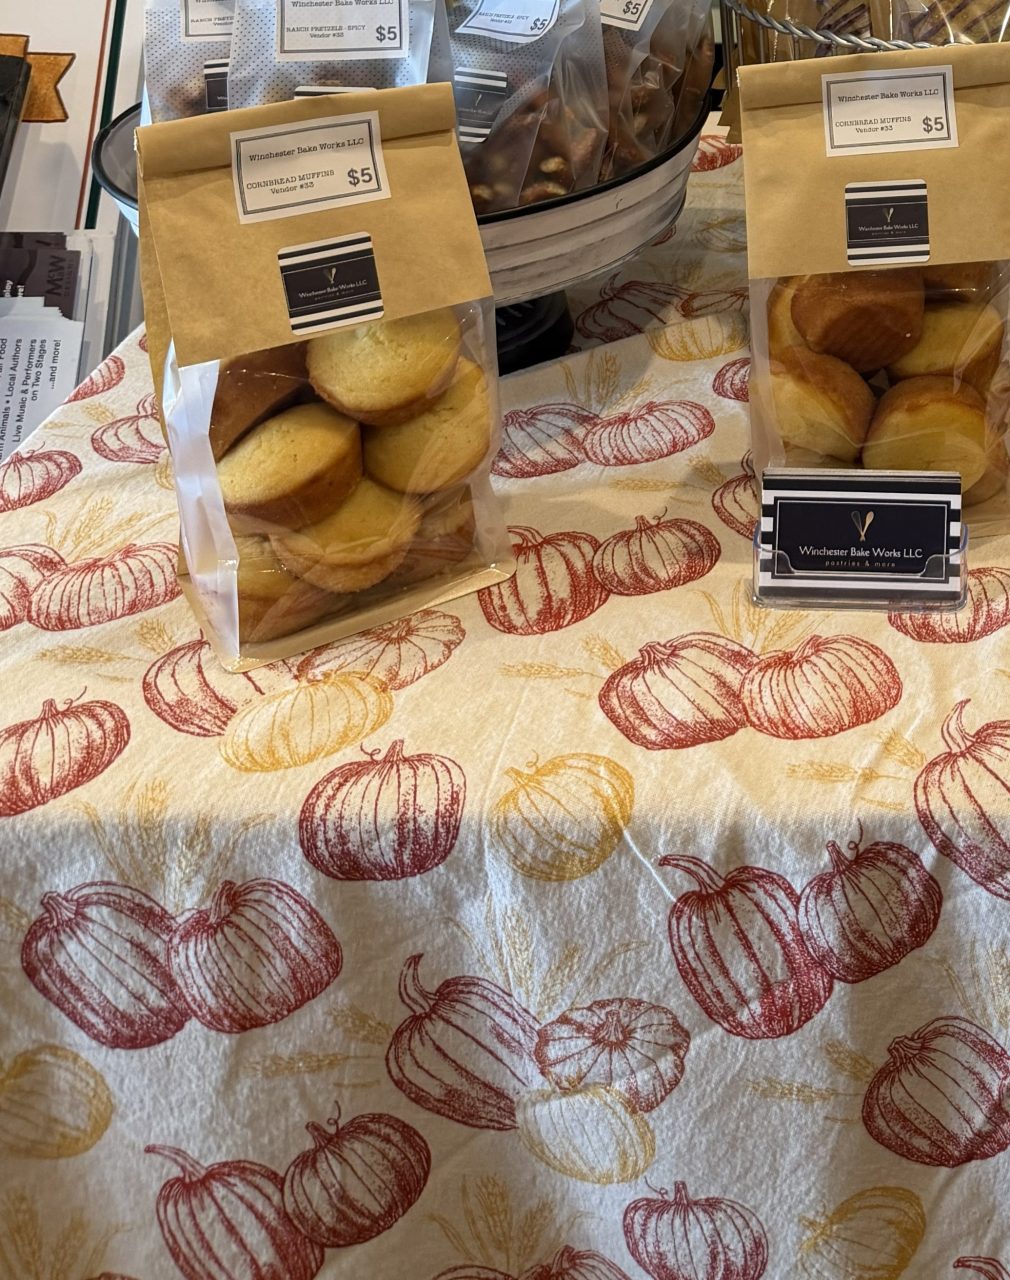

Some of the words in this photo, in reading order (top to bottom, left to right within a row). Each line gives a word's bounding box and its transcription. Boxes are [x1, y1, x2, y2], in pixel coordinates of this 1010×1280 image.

[622, 0, 642, 16] $5
[530, 17, 547, 31] $5
[375, 25, 398, 42] $5
[838, 93, 880, 103] Winchester
[880, 91, 899, 100] Bake
[899, 89, 923, 98] Works
[924, 88, 939, 96] LLC
[835, 117, 879, 128] CORNBREAD
[879, 115, 912, 125] MUFFINS
[922, 115, 945, 134] $5
[248, 148, 296, 162] Winchester
[297, 145, 318, 154] Bake
[318, 140, 346, 151] Works
[346, 137, 365, 147] LLC
[246, 175, 297, 190] CORNBREAD
[298, 169, 335, 182] MUFFINS
[347, 167, 373, 187] $5
[35, 338, 47, 369] Stages
[52, 339, 62, 365] more!
[23, 338, 37, 387] Performers
[32, 370, 42, 390] Two
[20, 390, 28, 400] &
[31, 391, 38, 402] on
[16, 401, 27, 428] Music
[13, 427, 22, 443] Live
[798, 546, 848, 557] Winchester
[850, 546, 871, 557] Bake
[871, 547, 902, 558] Works
[903, 548, 923, 559] LLC
